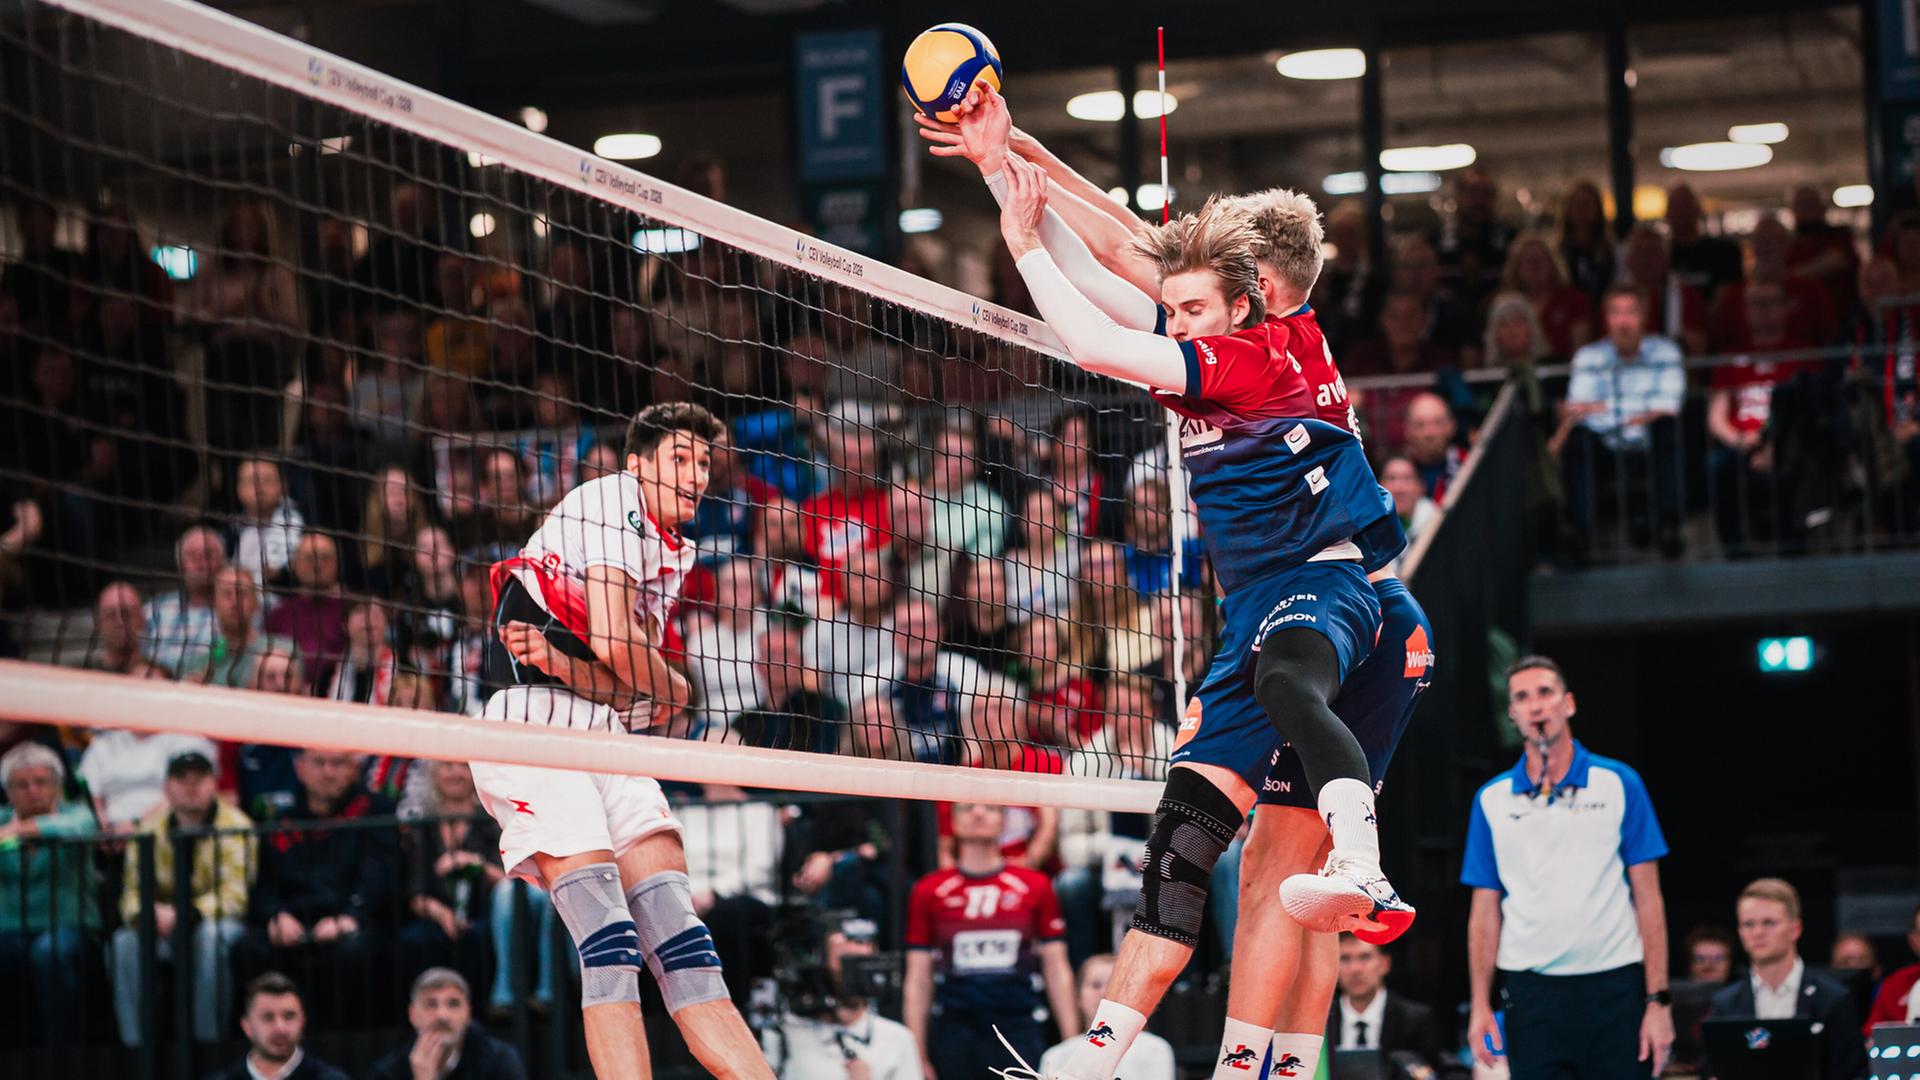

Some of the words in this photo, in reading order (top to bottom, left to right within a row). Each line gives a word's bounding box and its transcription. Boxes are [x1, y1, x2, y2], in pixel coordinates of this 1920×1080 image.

[953, 81, 967, 99] FIVB
[816, 75, 866, 140] F
[595, 168, 608, 185] CEV
[608, 171, 635, 196] Volleyball
[637, 183, 649, 202] Cup
[808, 246, 820, 262] CEV
[820, 250, 842, 271] Volleyball
[843, 258, 852, 276] Cup
[852, 262, 863, 277] 2026
[982, 308, 991, 322] CEV
[991, 312, 1010, 330] Volleyball
[1010, 319, 1019, 335] Cup
[1019, 321, 1029, 336] 2026
